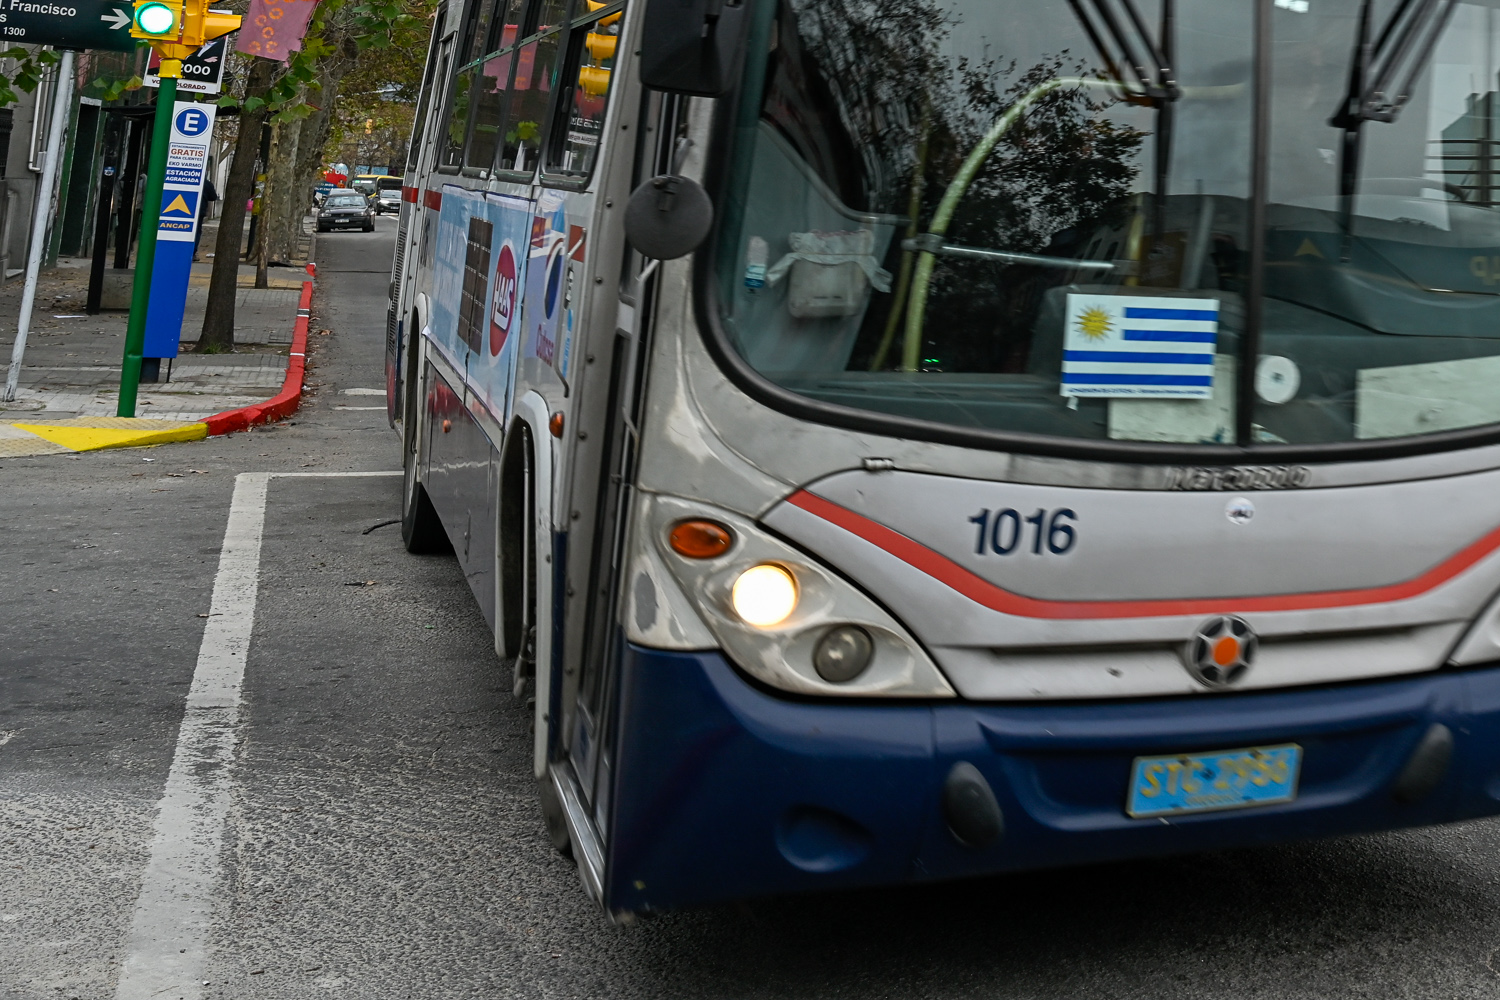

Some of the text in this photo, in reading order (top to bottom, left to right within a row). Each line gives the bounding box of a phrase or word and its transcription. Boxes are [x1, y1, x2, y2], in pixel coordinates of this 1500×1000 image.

[10, 0, 77, 17] Francisco
[3, 26, 26, 37] 1300
[176, 82, 206, 90] OLORADO
[184, 112, 200, 132] E
[171, 148, 204, 157] GRATIS
[166, 169, 200, 177] ESTACIÓN
[491, 271, 514, 330] HAAS
[967, 507, 1079, 556] 1016
